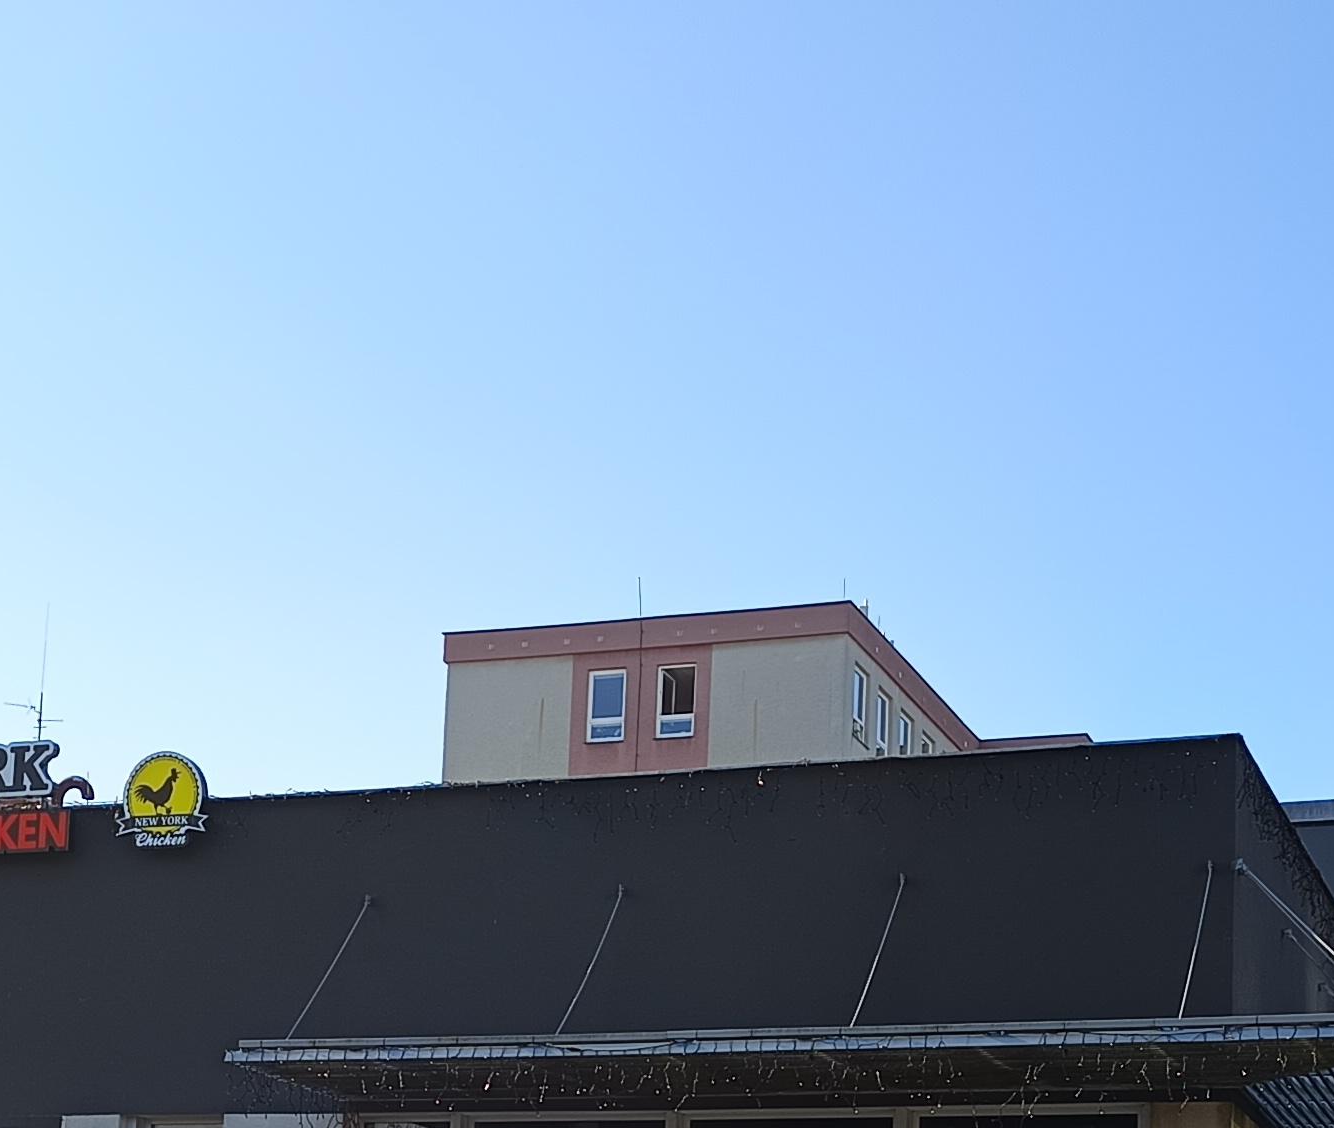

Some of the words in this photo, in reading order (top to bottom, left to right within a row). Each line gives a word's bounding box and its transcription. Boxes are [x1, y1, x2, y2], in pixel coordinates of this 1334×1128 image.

[135, 817, 159, 827] NEW
[160, 815, 188, 826] YORK
[135, 833, 188, 847] Chicken
